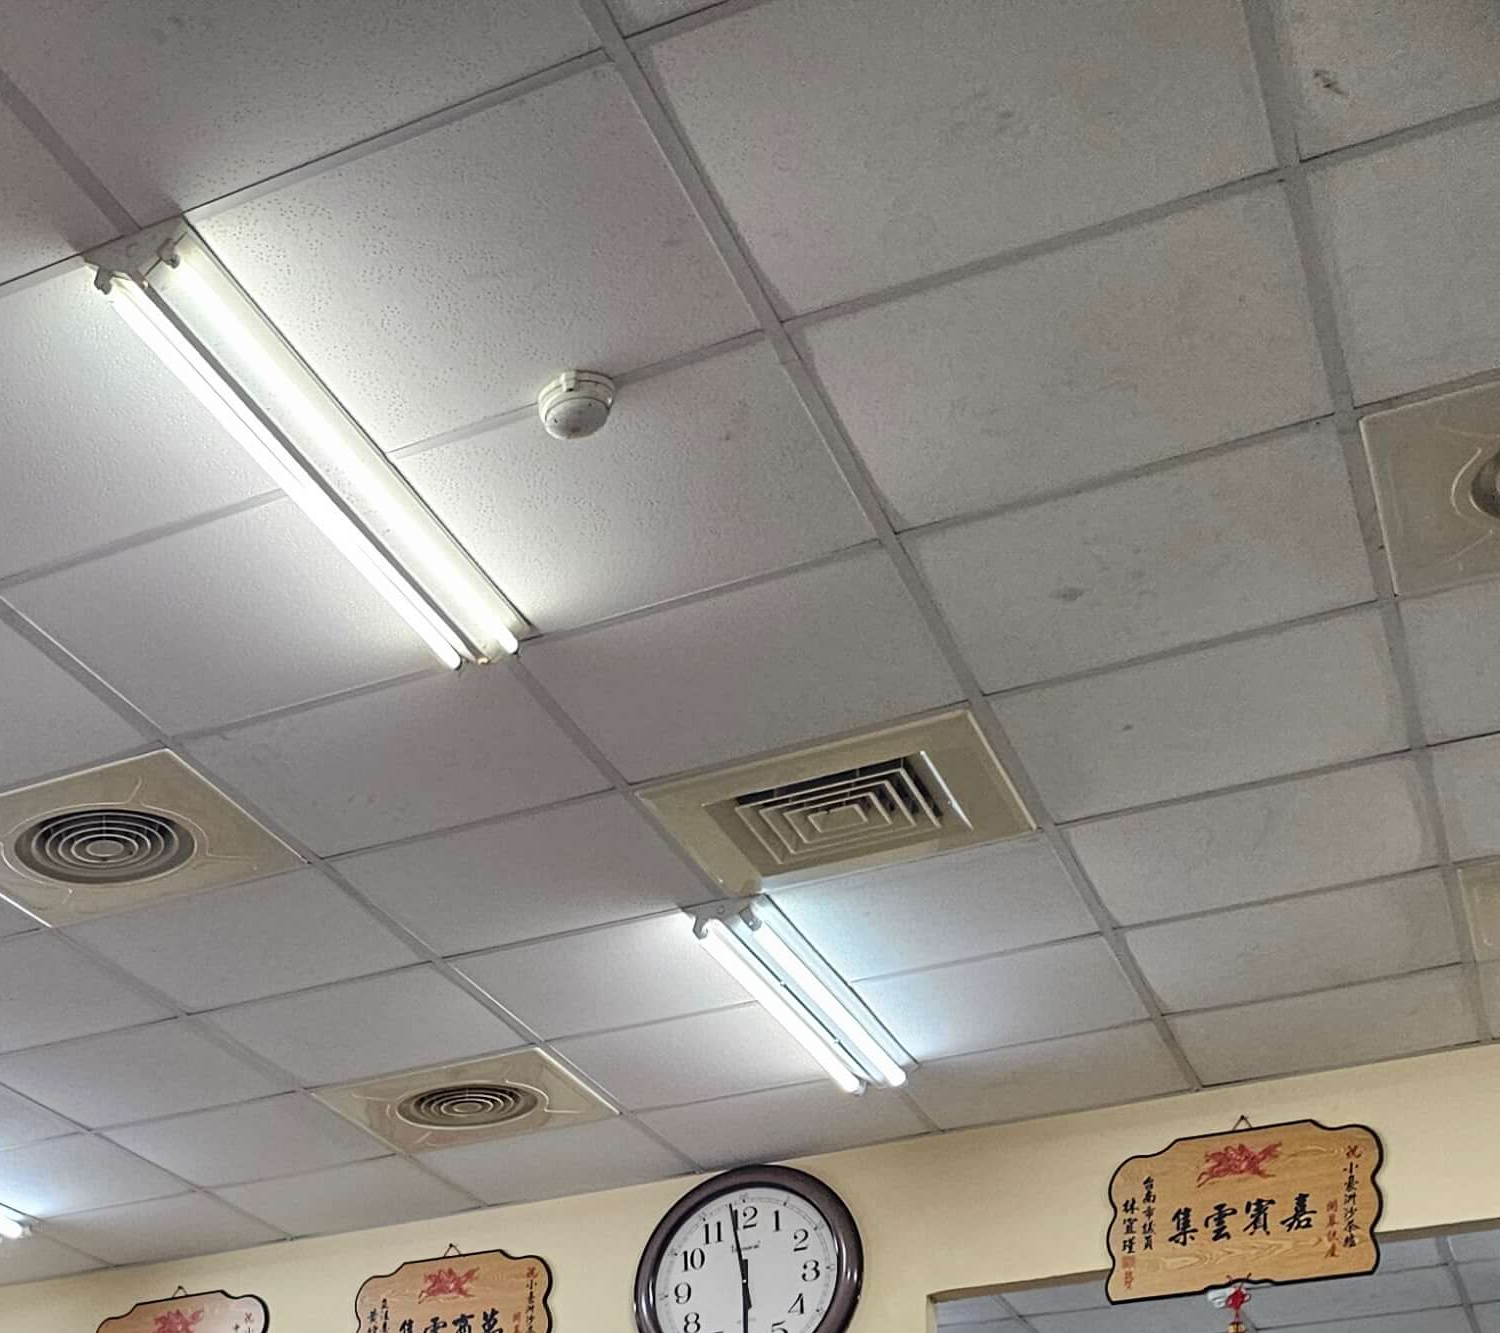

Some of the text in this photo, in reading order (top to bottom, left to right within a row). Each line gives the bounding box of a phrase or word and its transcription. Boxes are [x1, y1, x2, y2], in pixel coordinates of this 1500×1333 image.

[731, 1206, 758, 1232] 12
[772, 1209, 781, 1233] 1
[1168, 1193, 1319, 1247] 嘉賓雲集
[703, 1221, 724, 1245] 11
[793, 1228, 809, 1252] 2
[682, 1247, 705, 1272] 10
[802, 1259, 820, 1282] 3
[674, 1282, 692, 1305] 9
[788, 1292, 805, 1315] 4
